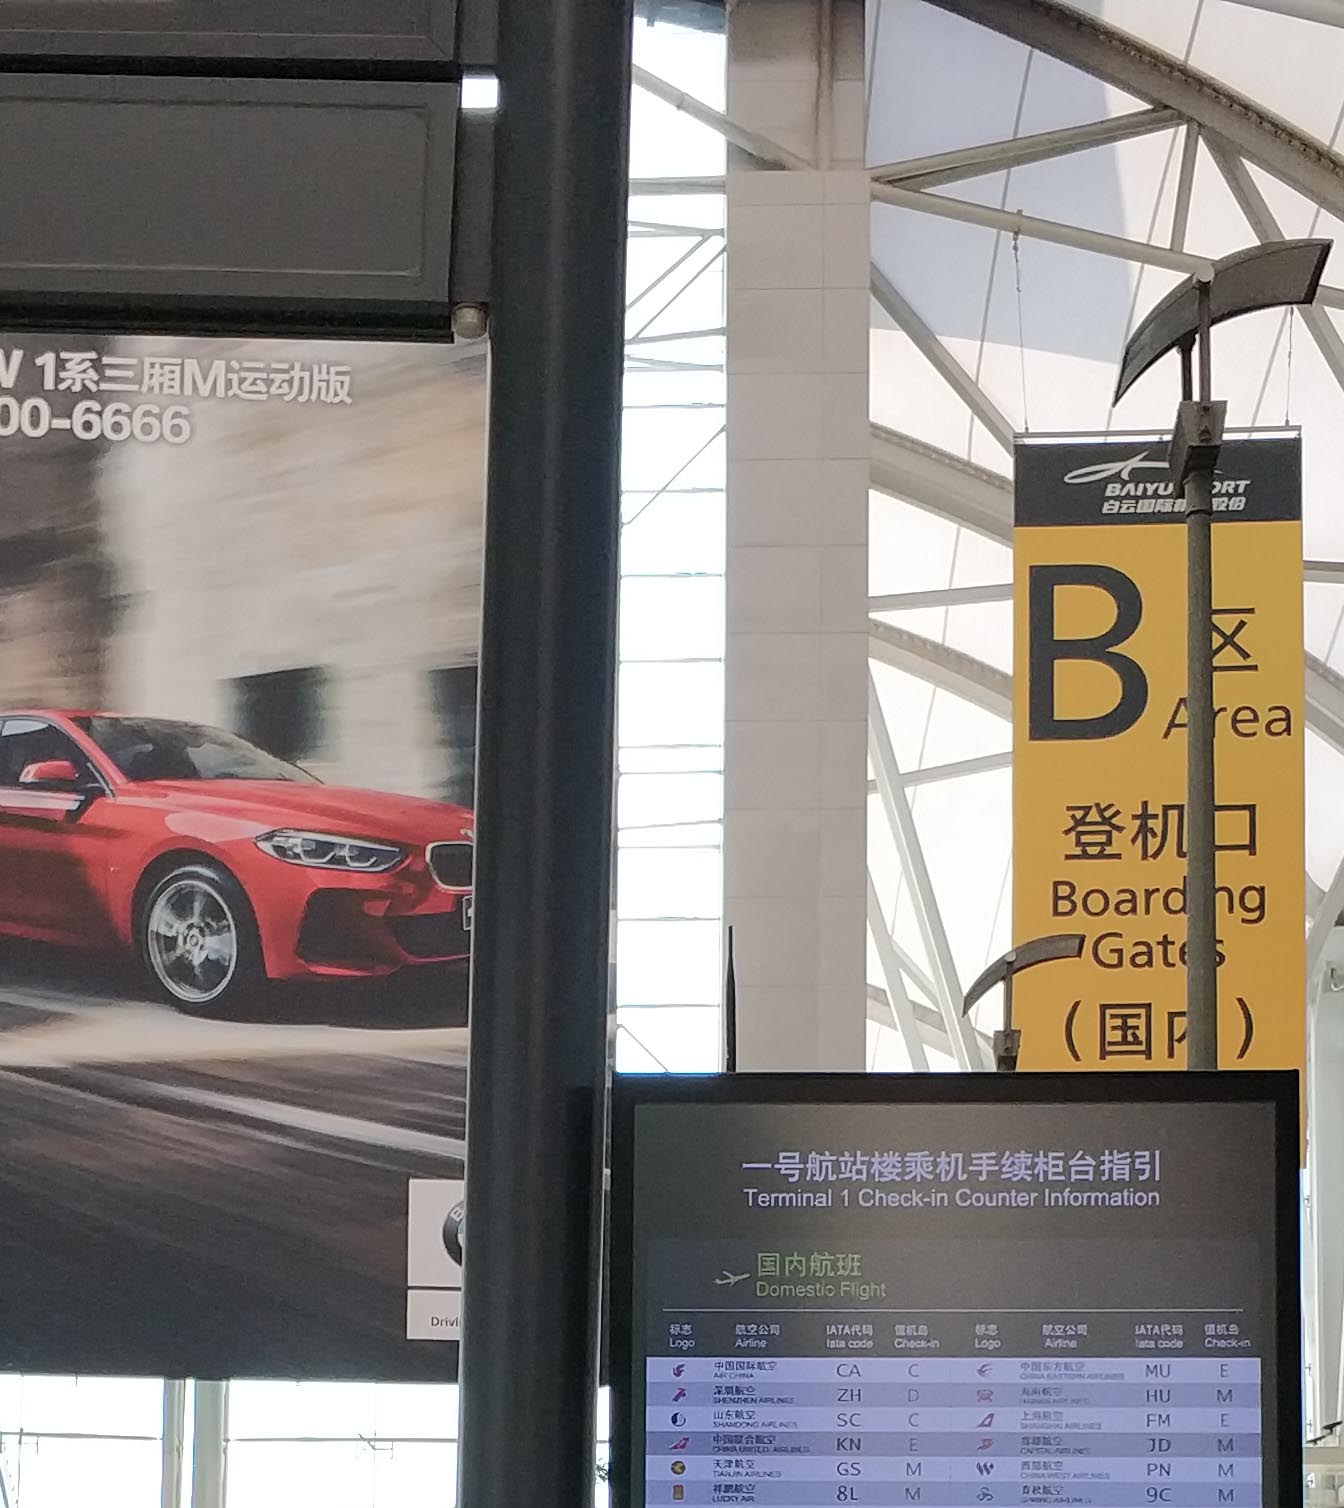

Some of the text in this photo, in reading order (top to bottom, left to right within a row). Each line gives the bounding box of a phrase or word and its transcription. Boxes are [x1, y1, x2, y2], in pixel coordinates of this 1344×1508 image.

[34, 350, 353, 406] 1系三厢M运动版
[1028, 564, 1149, 741] B
[1052, 878, 1266, 923] Boardng
[742, 1150, 1162, 1182] 一号航站楼乘机手续柜台指引
[743, 1188, 1161, 1208] Terminal 1 Check-in Counter Information
[757, 1252, 862, 1277] 国内航班
[757, 1281, 886, 1300] Domestic Flight
[736, 1324, 781, 1336] 航空公司
[826, 1324, 873, 1336] IATA代码
[670, 1338, 695, 1350] Logo
[736, 1338, 767, 1348] Airline
[848, 1339, 873, 1348] code
[895, 1338, 940, 1348] Check-in
[836, 1363, 862, 1378] CA
[1145, 1364, 1171, 1378] MU
[837, 1388, 862, 1402] ZH
[1145, 1389, 1171, 1403] HU
[837, 1413, 862, 1427] SC
[1146, 1414, 1171, 1428] FM
[836, 1437, 862, 1452] KN
[1149, 1439, 1171, 1452] JD
[836, 1462, 862, 1476] GS
[1147, 1463, 1172, 1477] PN
[836, 1486, 859, 1502] 8L
[1146, 1487, 1173, 1503] 9C
